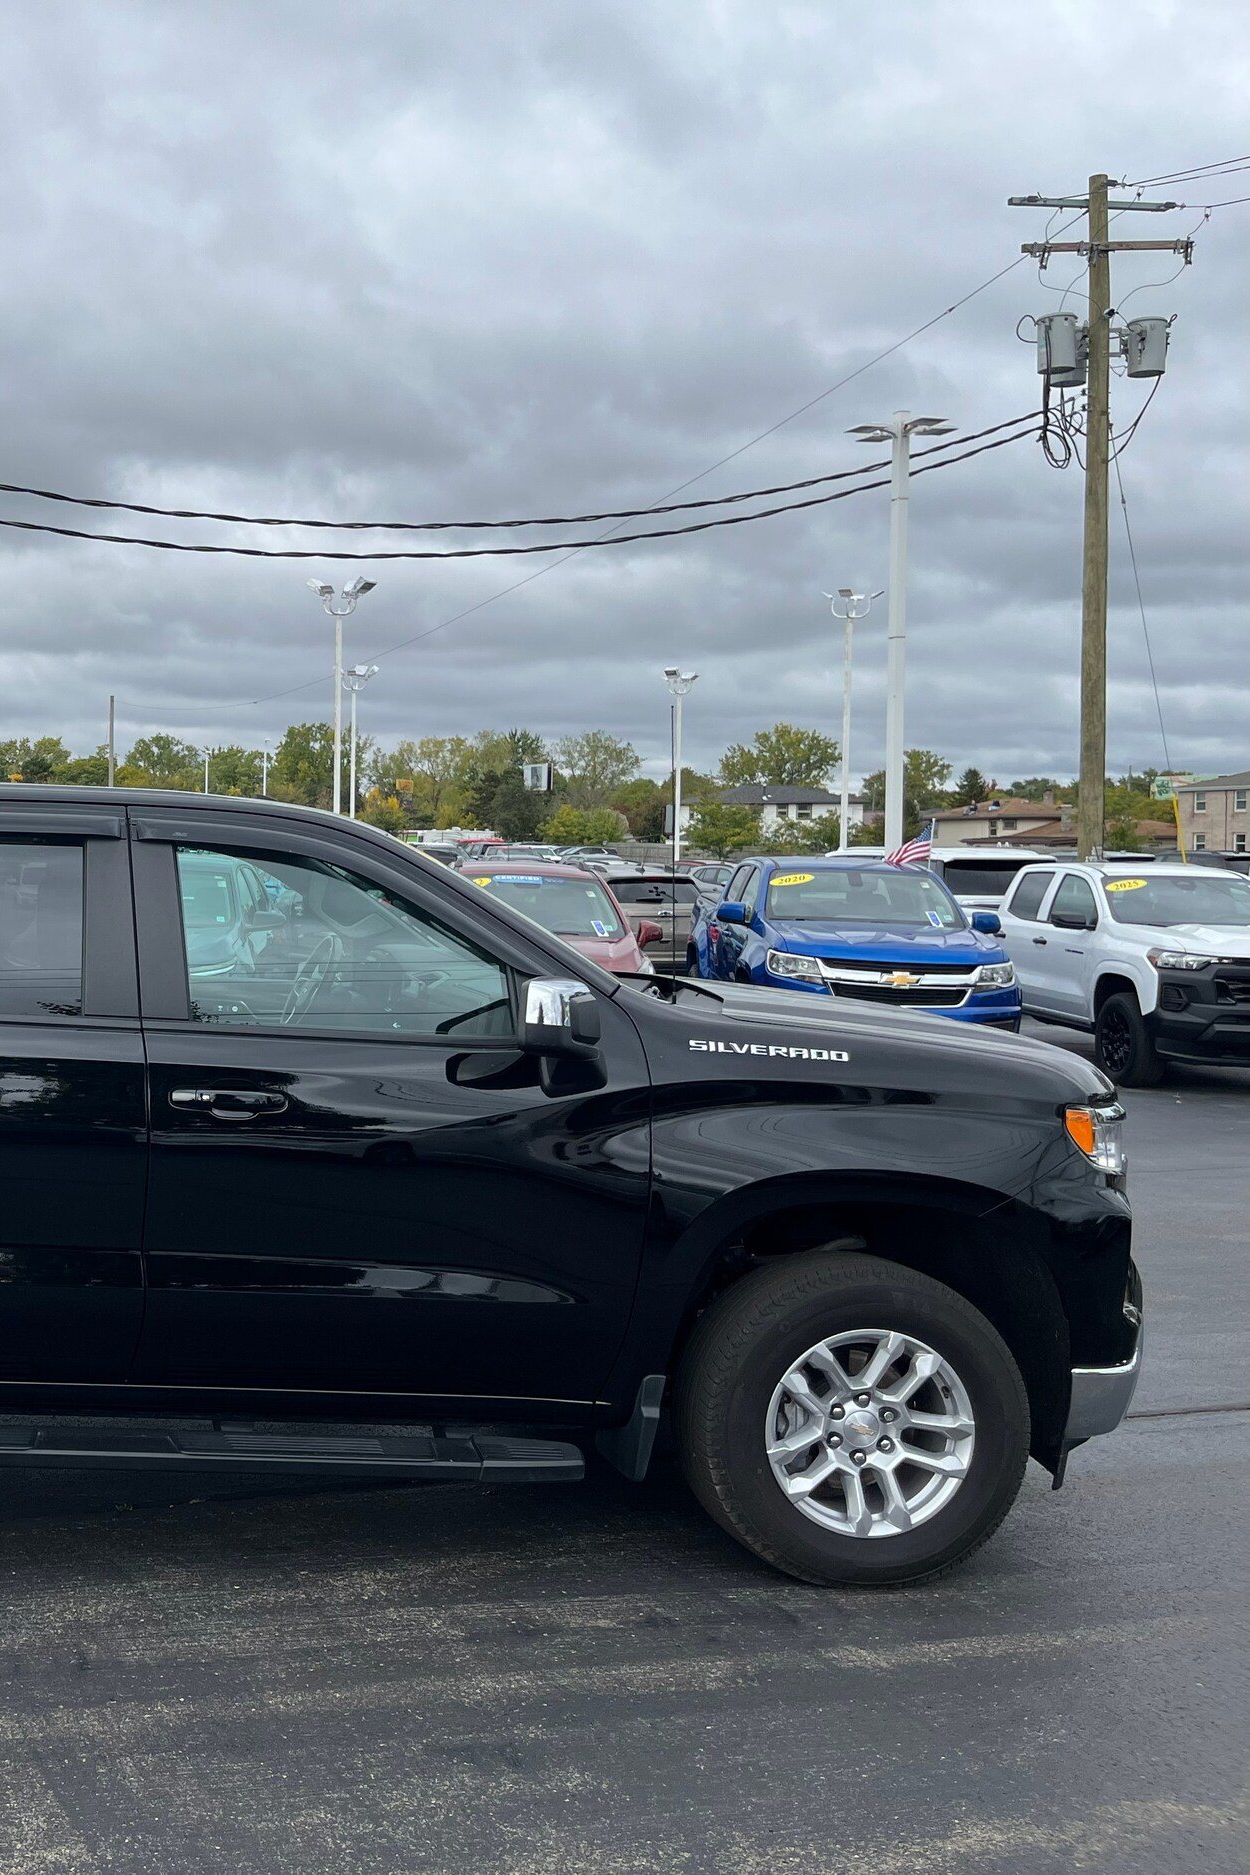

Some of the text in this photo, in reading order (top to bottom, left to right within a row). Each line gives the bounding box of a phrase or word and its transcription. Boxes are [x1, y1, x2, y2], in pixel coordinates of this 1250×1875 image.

[778, 875, 806, 885] 2020
[1114, 880, 1139, 890] 2025
[688, 1039, 849, 1062] SILVERADO
